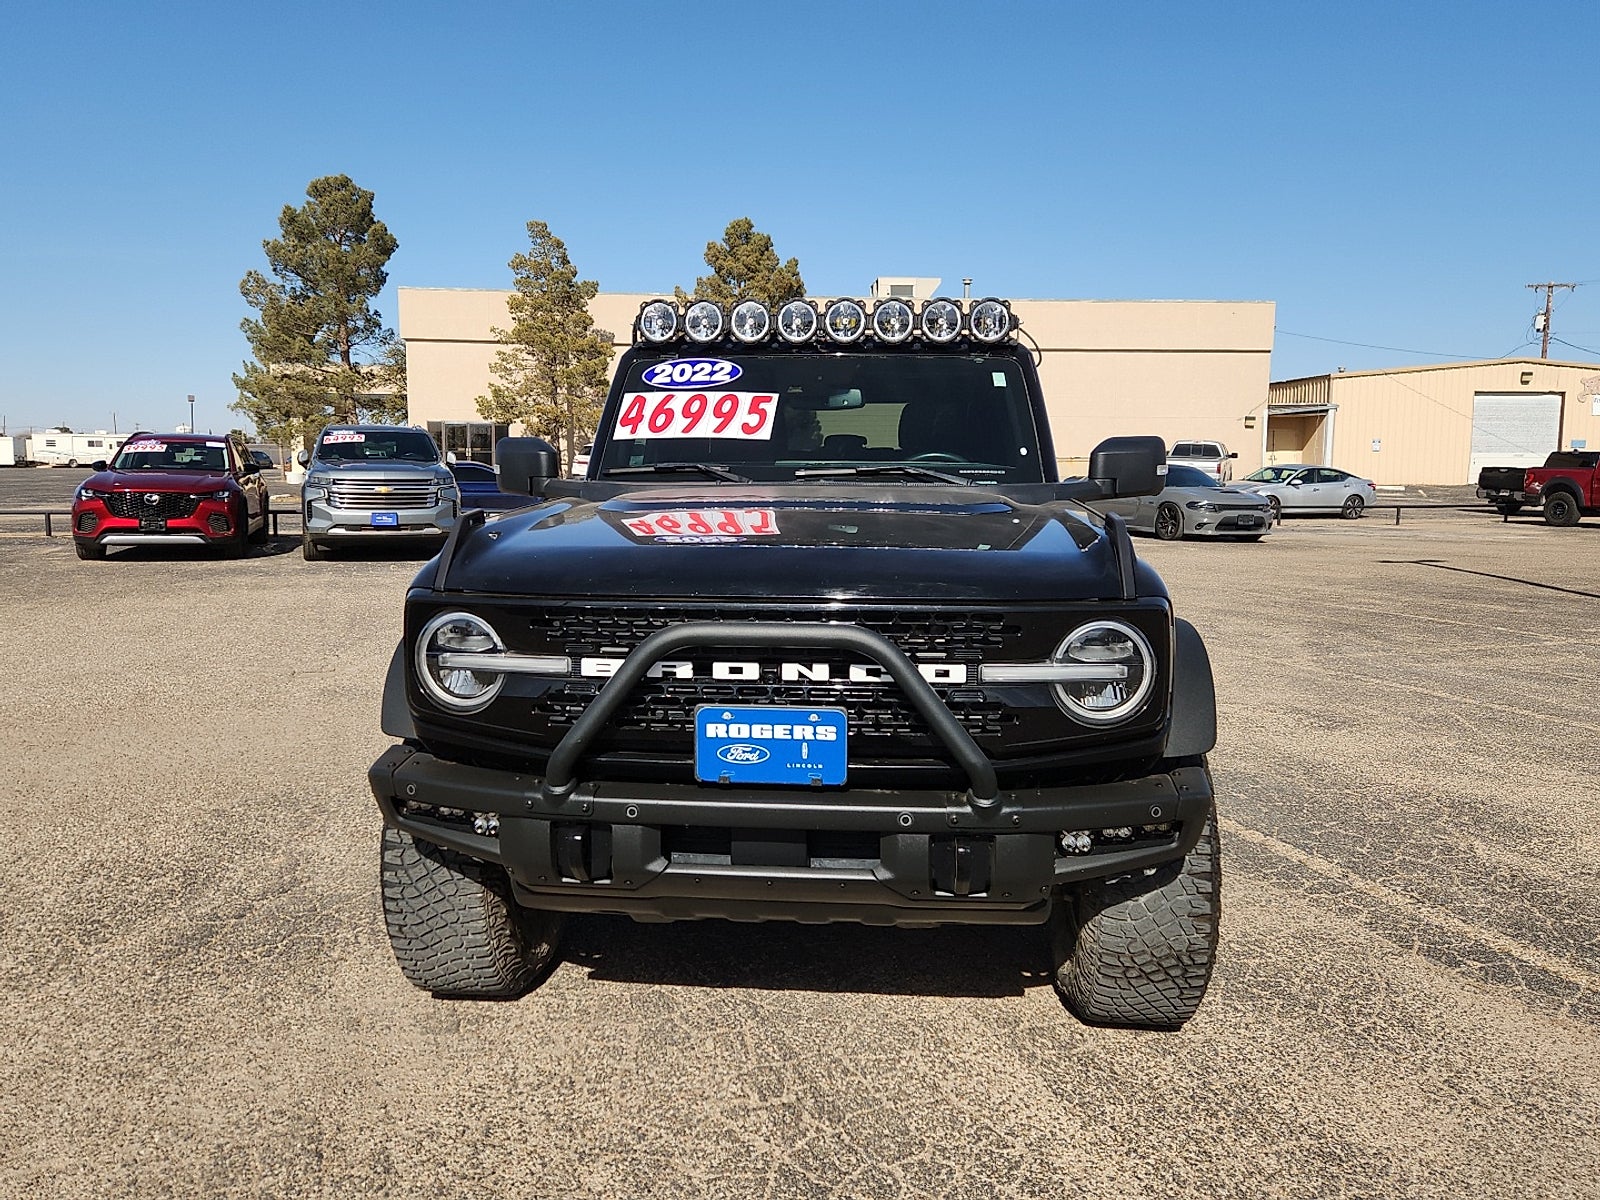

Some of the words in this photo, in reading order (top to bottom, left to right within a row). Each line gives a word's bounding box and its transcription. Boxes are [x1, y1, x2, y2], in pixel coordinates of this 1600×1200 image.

[652, 362, 733, 383] 2022
[619, 394, 773, 435] 46995
[581, 658, 967, 683] BRONCO
[706, 724, 837, 740] ROGERS
[727, 746, 760, 762] Ford
